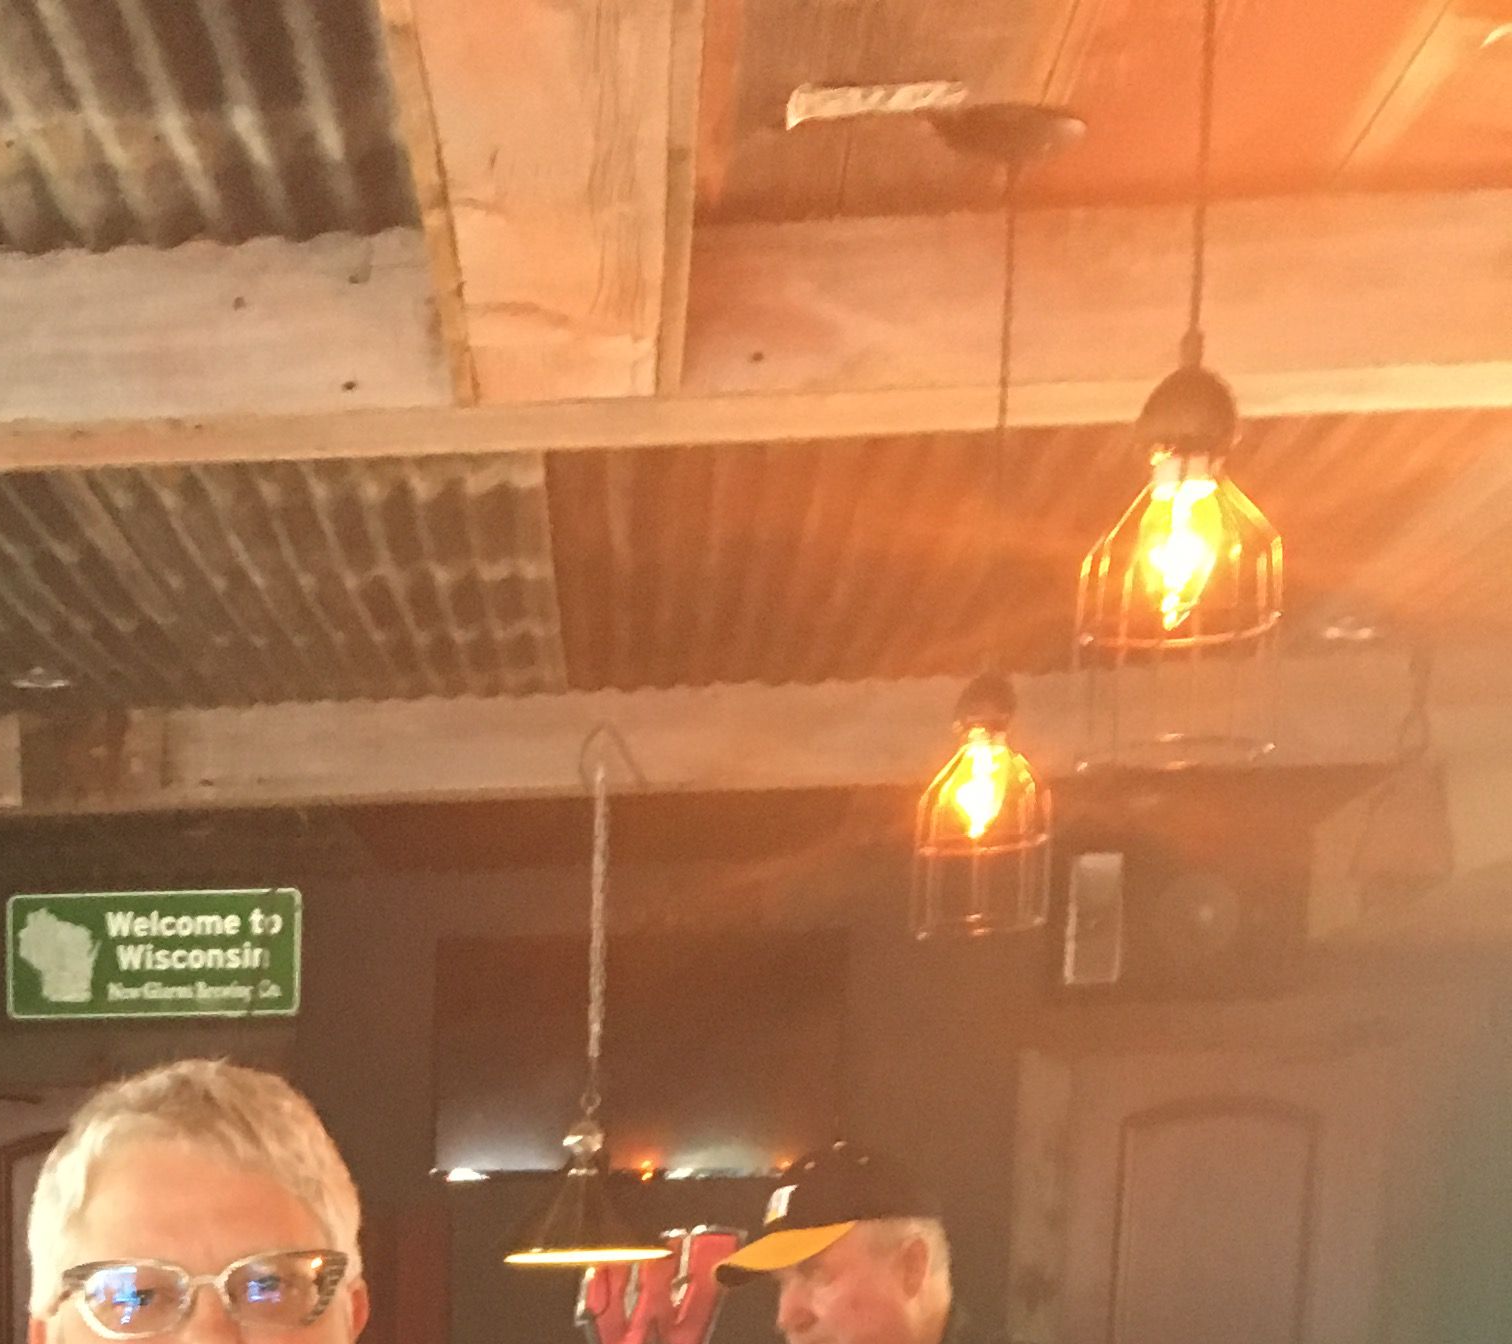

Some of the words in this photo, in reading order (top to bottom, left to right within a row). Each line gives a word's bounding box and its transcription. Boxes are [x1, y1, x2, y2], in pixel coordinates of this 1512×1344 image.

[105, 910, 241, 937] Welcome
[249, 907, 283, 935] to
[116, 941, 270, 971] Wisconsin
